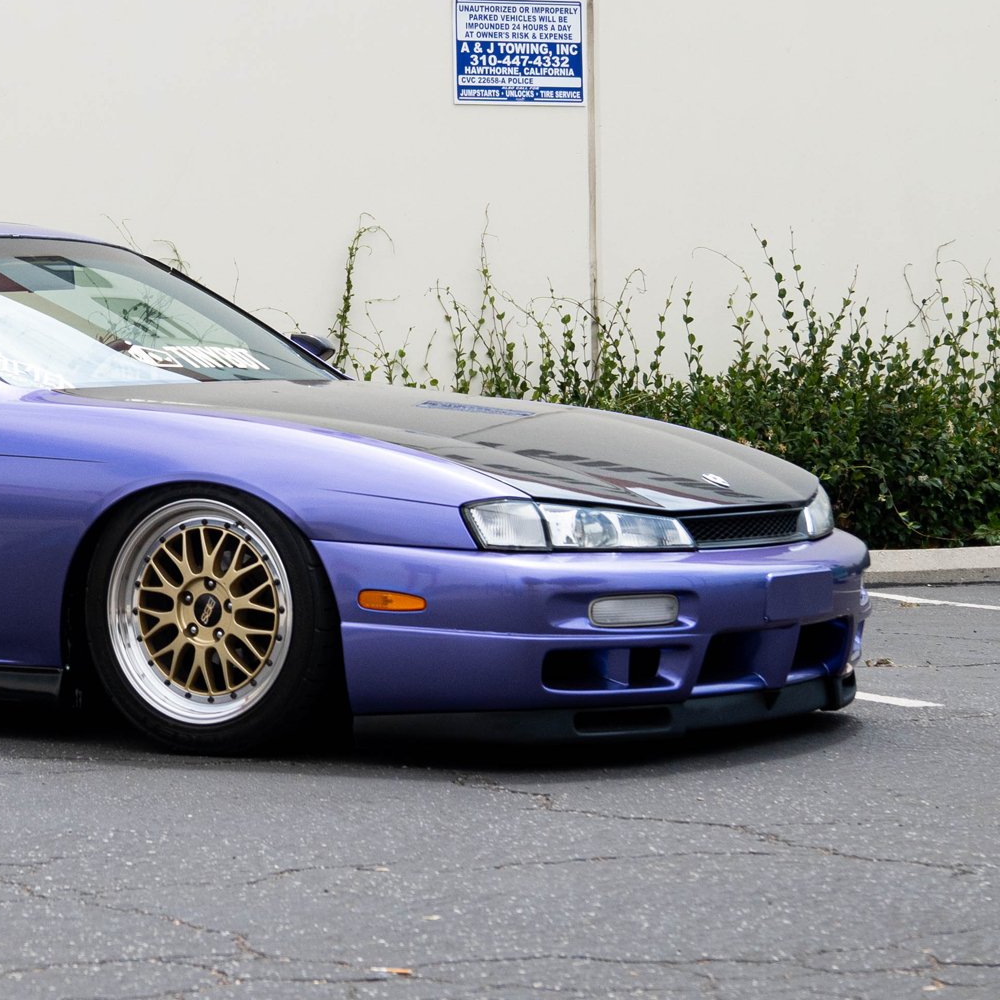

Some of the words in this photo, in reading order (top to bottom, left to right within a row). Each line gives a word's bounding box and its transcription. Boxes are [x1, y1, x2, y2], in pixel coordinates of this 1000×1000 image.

[458, 5, 517, 14] UNAUTHORIZED
[519, 6, 529, 14] OR
[532, 6, 578, 15] IMPROPERLY
[469, 14, 498, 22] PARKED
[501, 15, 537, 23] VEHICLES
[539, 15, 556, 23] WILL
[559, 16, 568, 24] BE
[465, 22, 510, 31] IMPOUNDED
[512, 23, 520, 31] 24
[523, 24, 548, 32] HOURS
[465, 31, 474, 39] AT
[476, 31, 510, 39] OWNER'S
[512, 32, 529, 40] RISK
[540, 33, 573, 41] EXPENSE
[460, 42, 470, 54] A
[473, 42, 483, 54] &
[487, 42, 494, 54] J
[498, 43, 553, 56] TOWING,
[556, 44, 578, 56] INC
[469, 55, 570, 68] 310-447-4332
[464, 66, 522, 77] HAWTHORNE,
[523, 67, 575, 77] CALIFORNIA
[461, 76, 476, 84] CVC
[478, 77, 506, 85] 22658-A
[460, 89, 500, 97] JUMPSTARTS
[505, 90, 535, 98] UNLOCKS
[540, 90, 555, 98] TIRE
[555, 91, 581, 99] SERVICE
[200, 596, 216, 625] BBS
